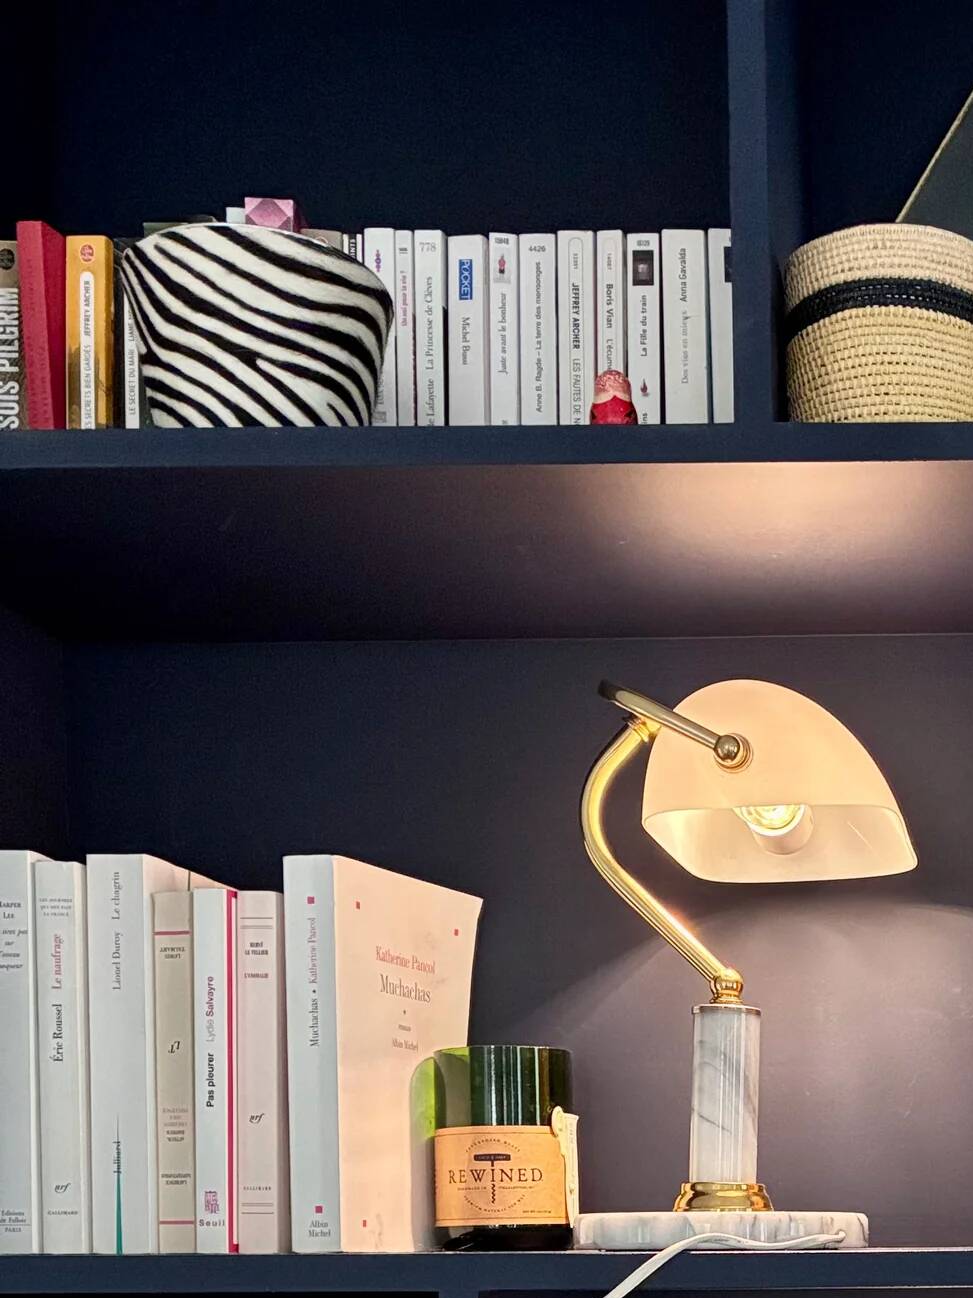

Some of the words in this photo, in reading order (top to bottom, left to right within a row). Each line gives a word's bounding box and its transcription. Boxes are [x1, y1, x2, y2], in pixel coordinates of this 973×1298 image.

[678, 247, 687, 280] Gavalda
[424, 276, 433, 303] Clèves
[459, 259, 473, 299] POCKET
[679, 281, 687, 302] Anna
[83, 280, 92, 308] ARCHER
[572, 283, 580, 316] JEFFREY
[606, 283, 614, 305] Boris
[640, 294, 648, 314] train
[425, 305, 433, 318] de
[498, 293, 507, 323] bonheur
[606, 307, 614, 329] Vian
[640, 315, 648, 328] du
[0, 287, 19, 372] PILGRIM
[83, 308, 92, 336] JEFFREY
[462, 316, 471, 345] Michel
[572, 317, 580, 350] ARCHER
[425, 319, 433, 356] Princesse
[535, 339, 542, 351] La
[426, 357, 433, 370] La
[572, 358, 581, 372] LES
[640, 347, 648, 357] La
[425, 377, 436, 412] Lafayette
[535, 382, 542, 393] B.
[572, 373, 581, 403] FAUTES
[0, 381, 20, 430] SUIS
[572, 404, 581, 417] DE
[111, 871, 122, 906] chagrin
[111, 908, 120, 920] Le
[51, 933, 64, 975] naufrage
[112, 932, 124, 962] Duroy
[375, 945, 411, 969] Katherine
[51, 977, 62, 990] Le
[112, 964, 121, 991] Lionel
[379, 973, 432, 1003] Muchachas
[51, 1003, 63, 1040] Roussel
[308, 997, 320, 1047] Muchachas
[50, 1042, 64, 1062] Éric
[206, 1089, 215, 1107] Pas
[448, 1167, 544, 1184] REWINED
[199, 1219, 226, 1227] Seuil
[308, 1228, 331, 1238] Michel
